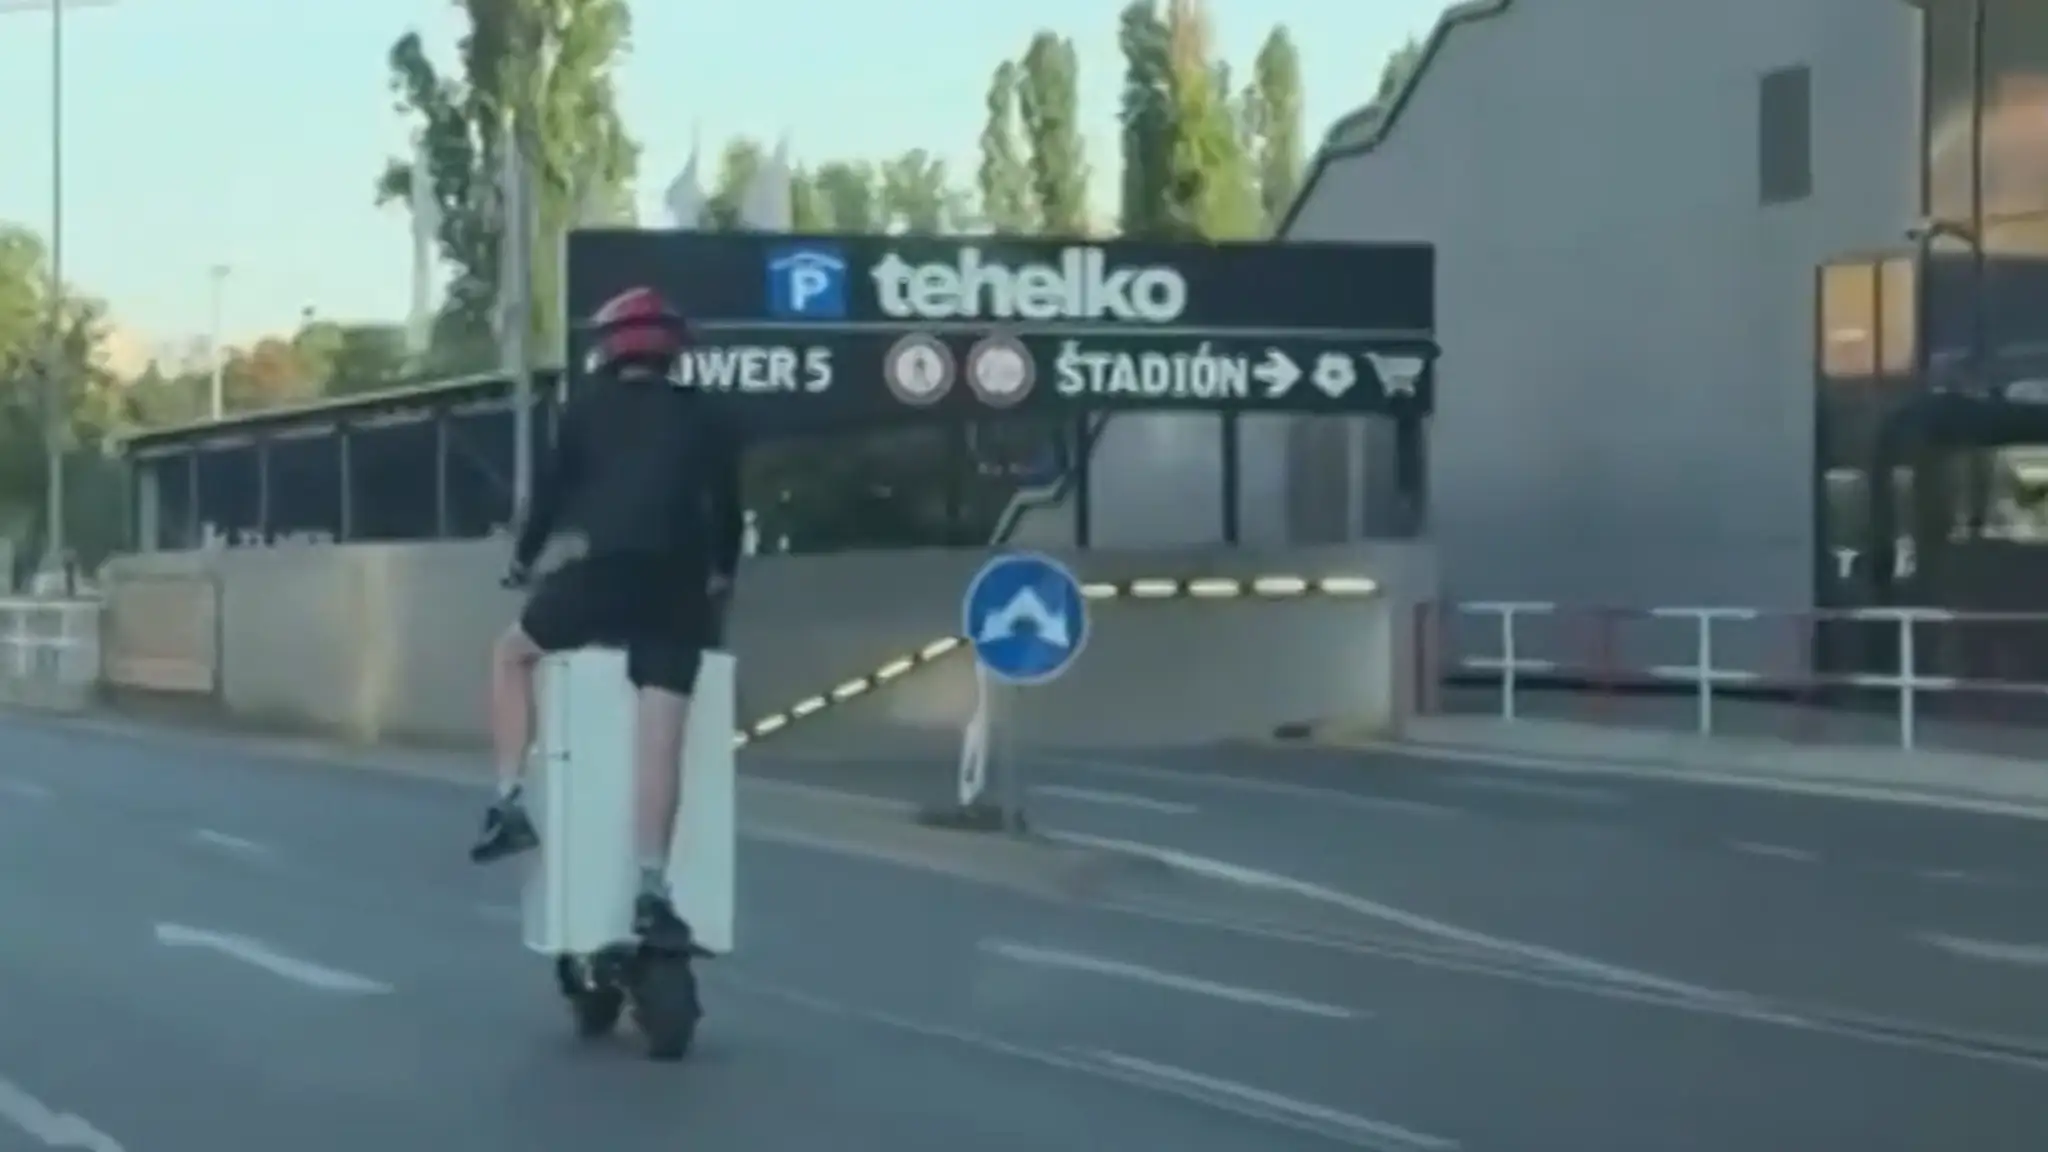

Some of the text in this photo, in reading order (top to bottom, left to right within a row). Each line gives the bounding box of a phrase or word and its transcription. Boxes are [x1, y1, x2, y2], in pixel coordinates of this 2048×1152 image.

[789, 246, 1187, 321] P tehelko
[804, 346, 833, 392] 5
[1055, 339, 1249, 398] ŠTADIÓN
